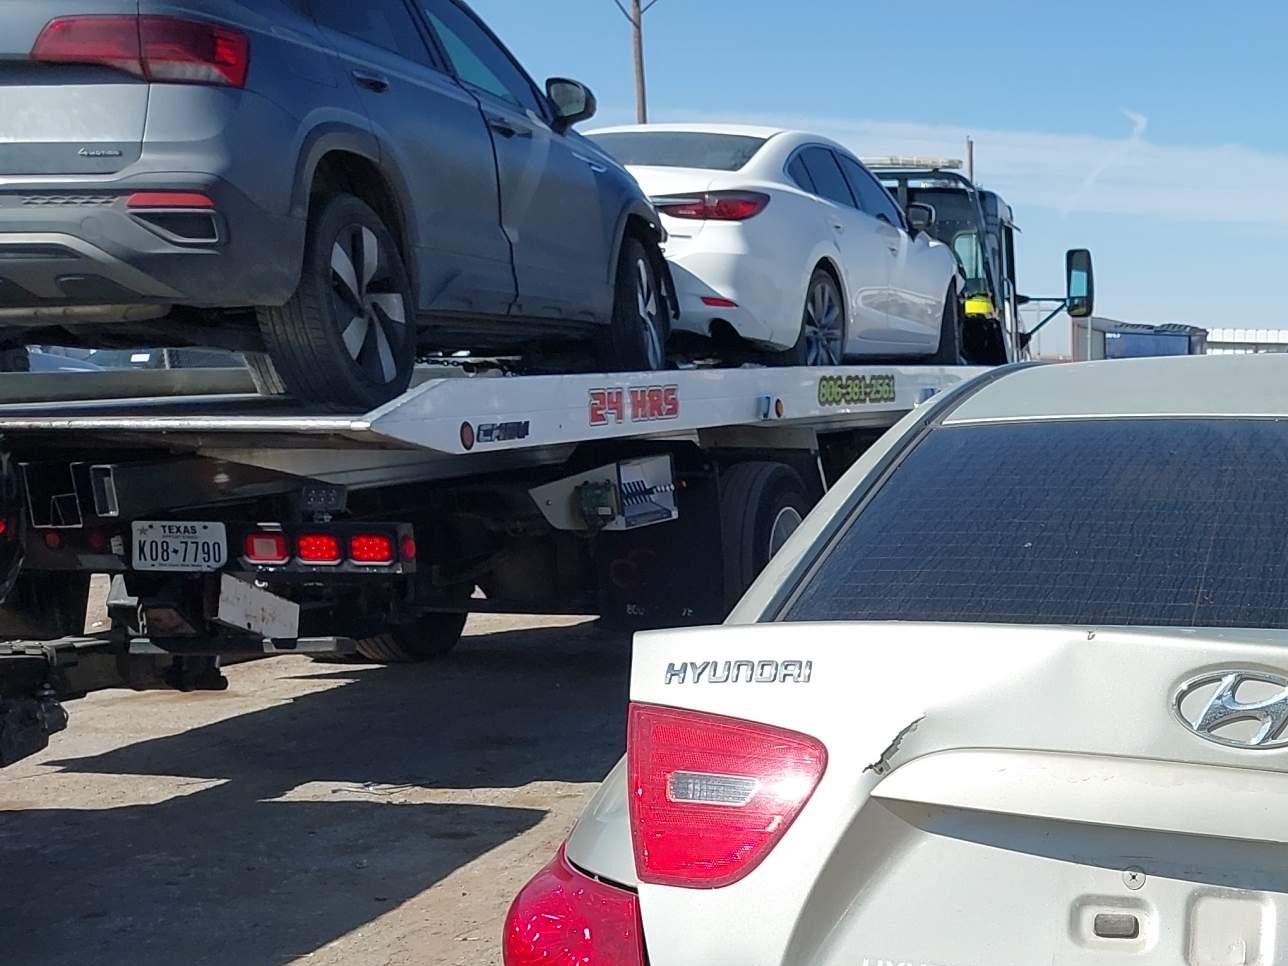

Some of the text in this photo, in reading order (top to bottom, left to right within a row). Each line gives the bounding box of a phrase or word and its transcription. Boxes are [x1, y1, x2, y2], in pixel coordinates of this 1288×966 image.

[588, 384, 679, 426] 24 HRS
[161, 525, 198, 535] TEXAS
[664, 660, 813, 685] HYUNDAI
